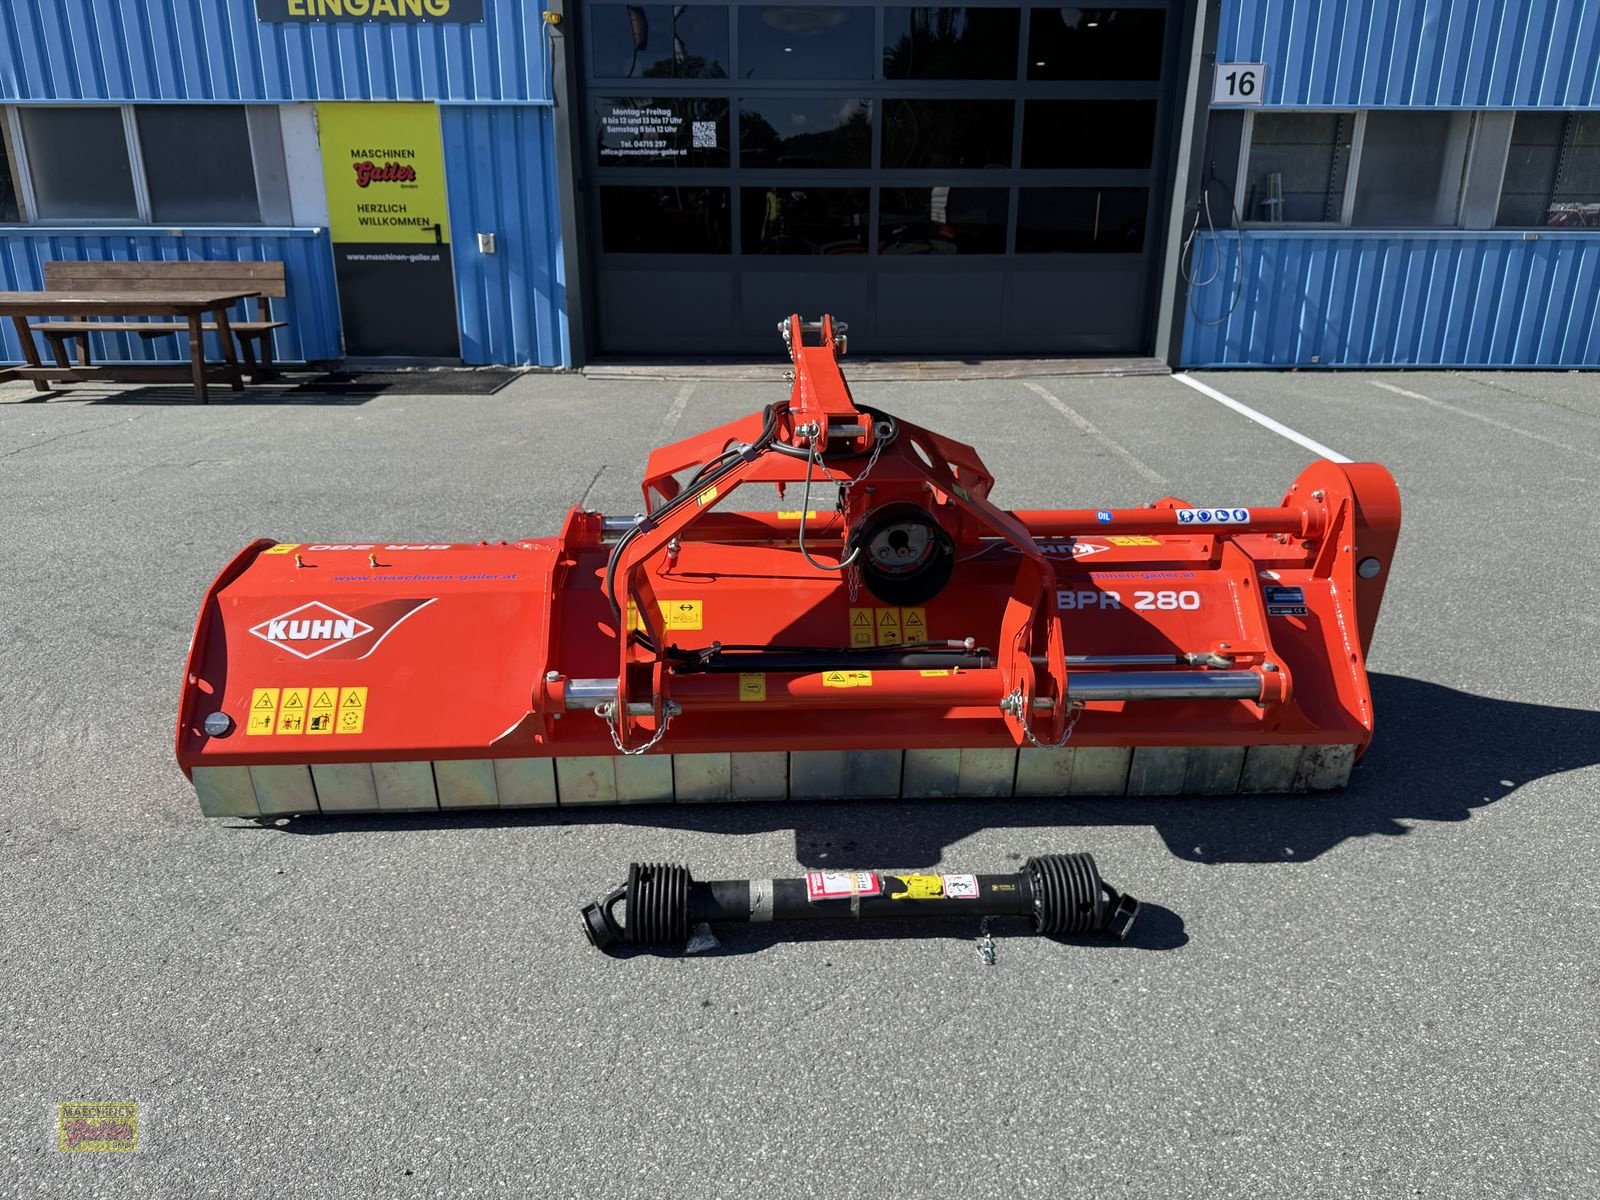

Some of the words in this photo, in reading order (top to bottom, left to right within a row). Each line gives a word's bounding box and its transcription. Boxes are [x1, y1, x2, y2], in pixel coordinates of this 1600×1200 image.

[287, 0, 450, 16] EINGANG
[1225, 71, 1256, 96] 16
[612, 108, 640, 117] Montag
[646, 108, 671, 117] Freitag
[606, 126, 638, 135] Samstag
[351, 149, 415, 158] MASCHINEN
[353, 161, 416, 188] Gailer
[357, 204, 407, 213] HERZLICH
[358, 217, 430, 226] WILLKOMMEN
[346, 253, 440, 262] www.maschinen-gailer.at
[1098, 511, 1110, 521] OIL
[1057, 590, 1121, 610] BPR
[1133, 590, 1200, 610] 280
[267, 619, 356, 641] KUHN
